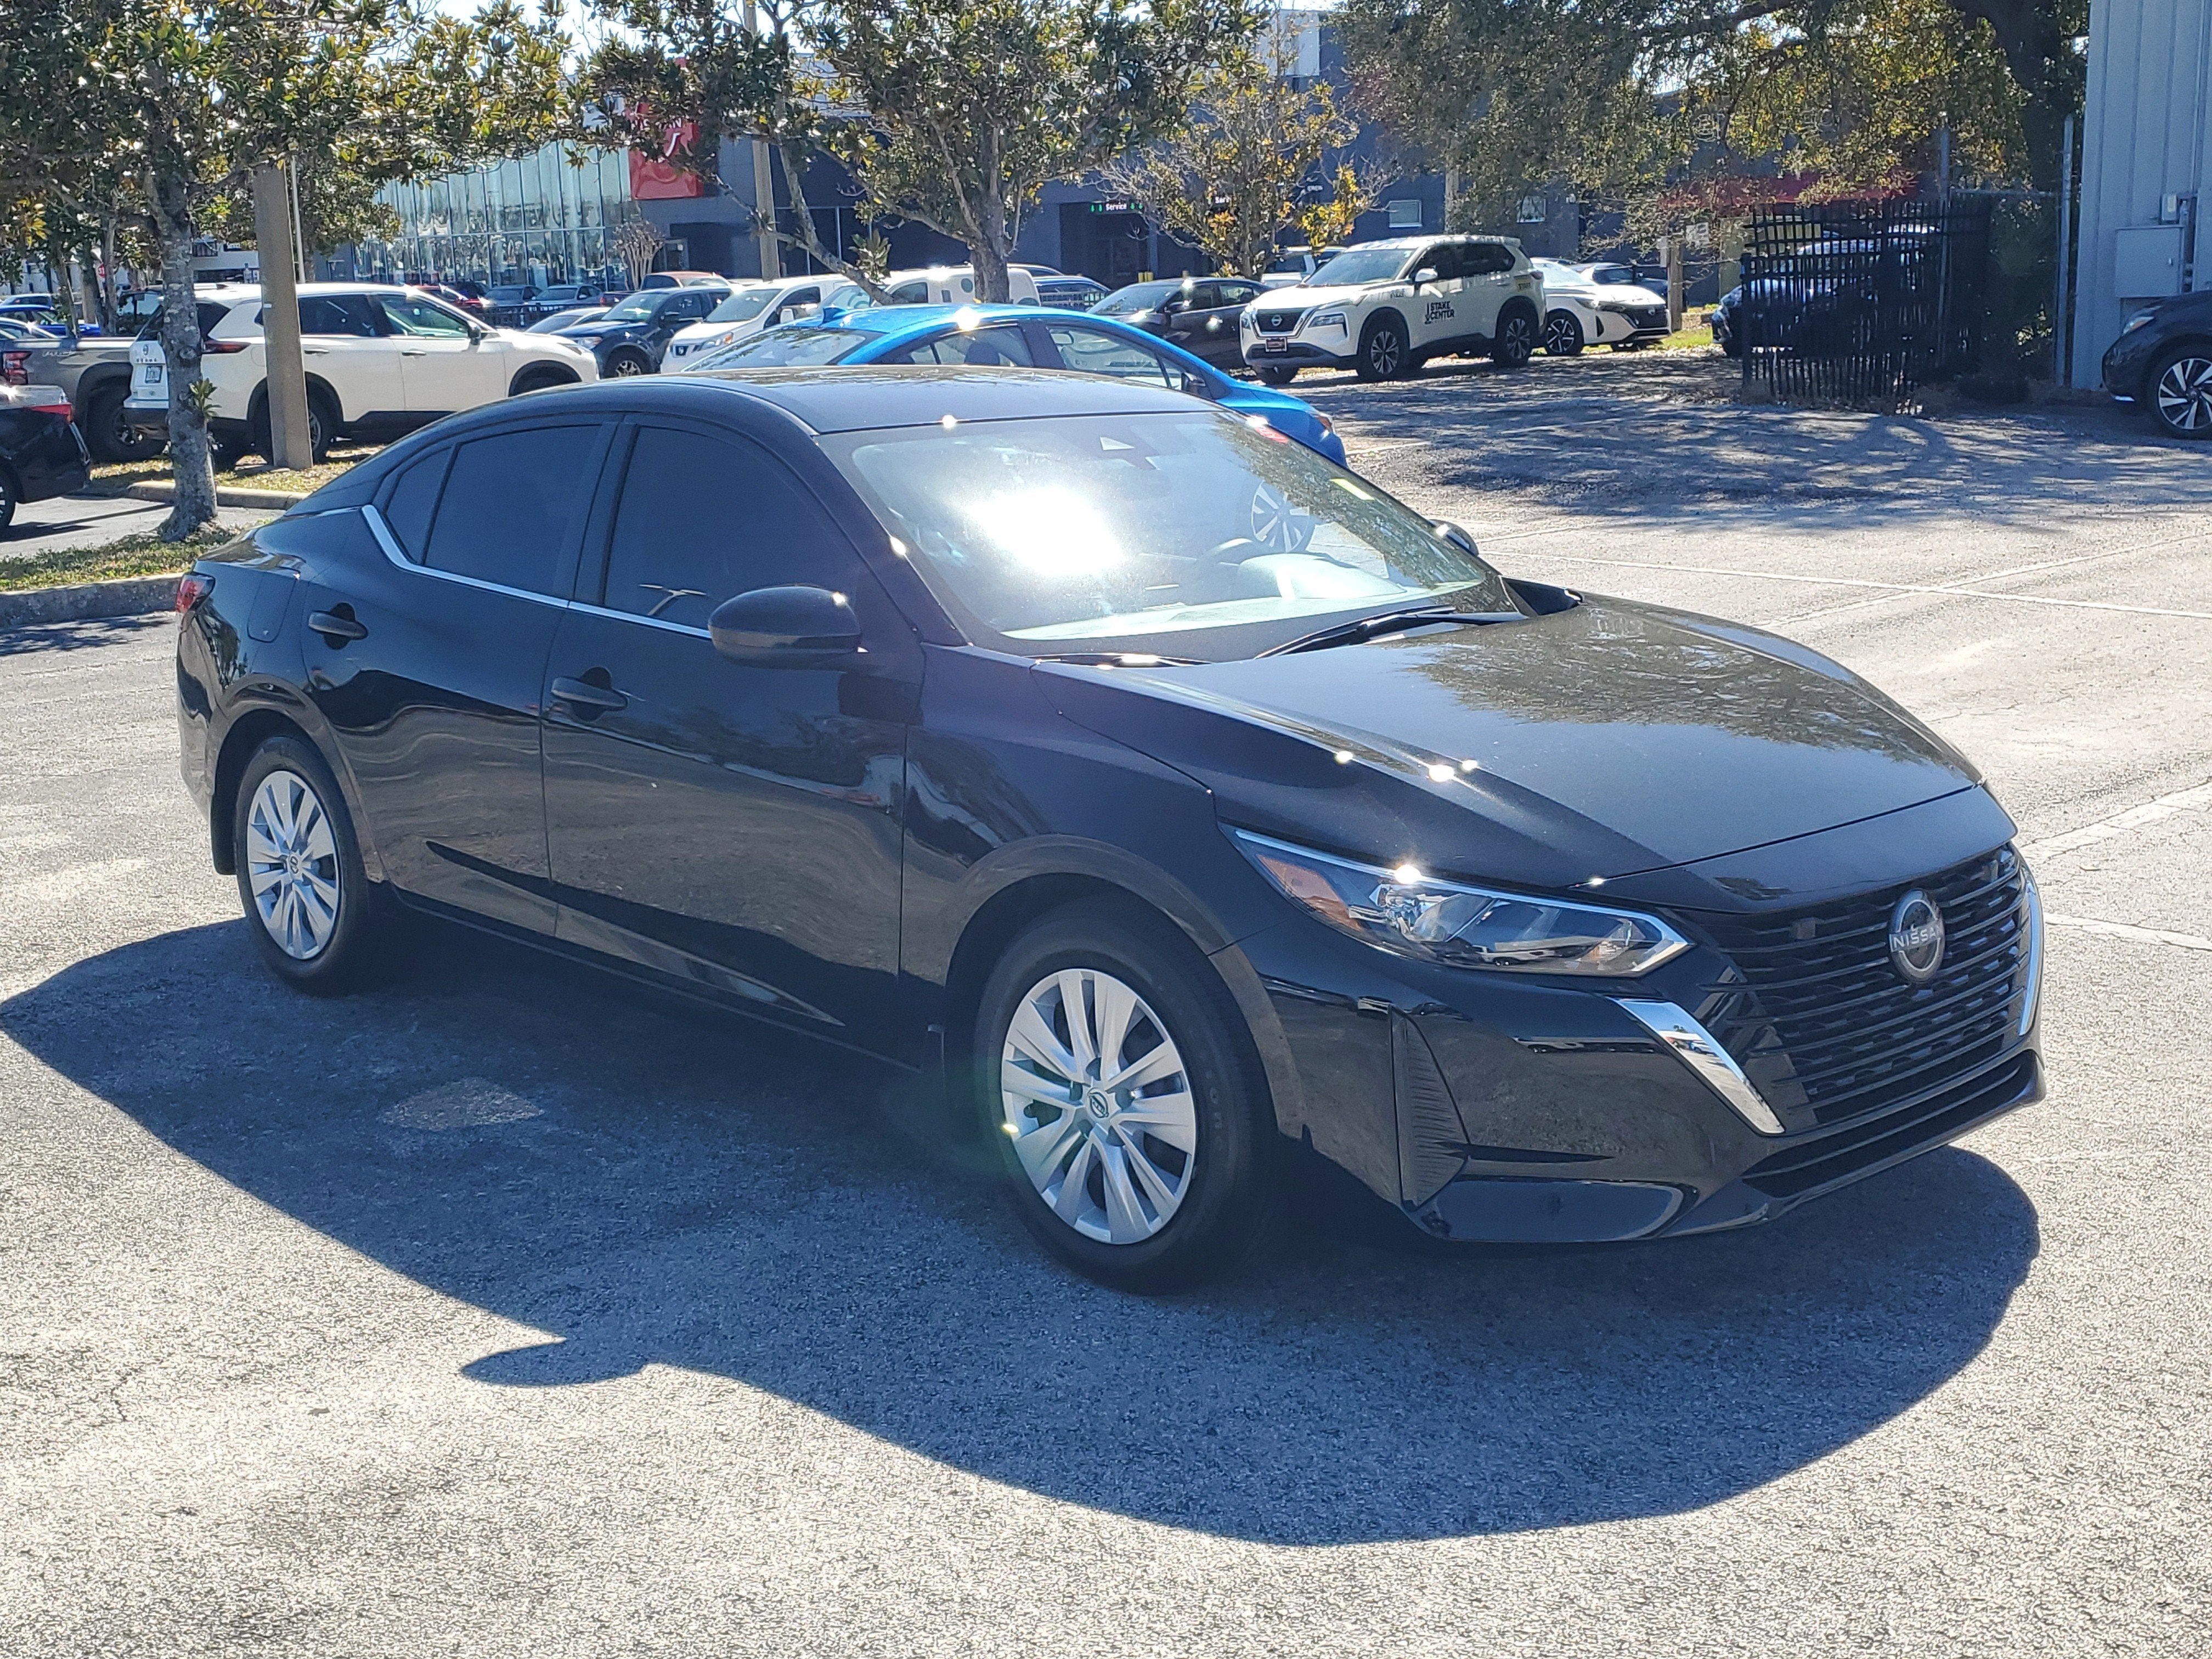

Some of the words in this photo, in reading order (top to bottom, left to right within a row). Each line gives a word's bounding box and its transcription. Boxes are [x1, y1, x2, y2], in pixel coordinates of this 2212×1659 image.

[1105, 202, 1127, 211] Service
[1430, 300, 1451, 311] STAKE
[1430, 309, 1455, 320] CENTER
